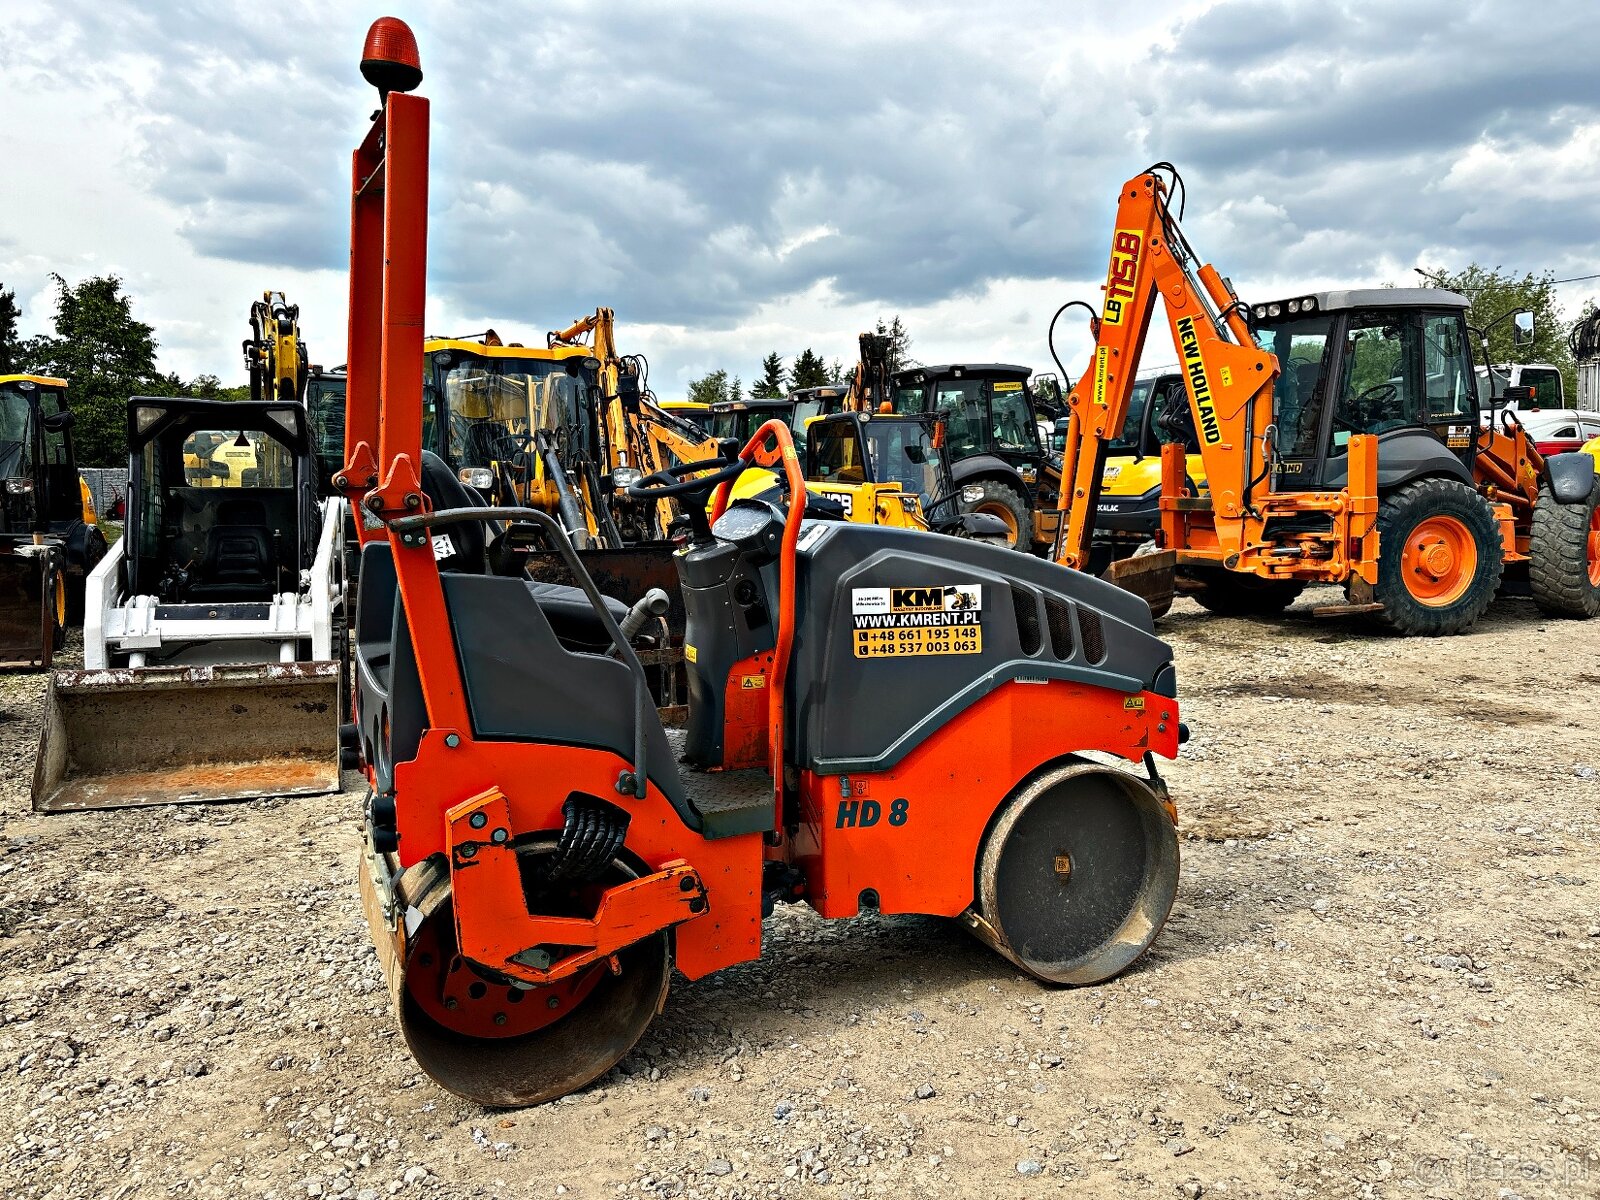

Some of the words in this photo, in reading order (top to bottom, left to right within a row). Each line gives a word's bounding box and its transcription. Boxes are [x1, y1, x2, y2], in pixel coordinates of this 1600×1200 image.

[1105, 300, 1121, 323] LB
[1177, 317, 1200, 359] NEW
[1097, 347, 1107, 402] www.kmrent.pl
[1188, 362, 1220, 444] HOLLAND
[893, 589, 943, 607] KM
[854, 612, 980, 628] WWW.KMRENT.PL
[870, 631, 895, 641] +48
[898, 630, 921, 640] 661
[926, 629, 949, 639] 195
[954, 628, 977, 638] 148
[871, 644, 895, 654] +48
[899, 643, 922, 653] 537
[926, 642, 949, 652] 003
[953, 641, 977, 651] 063
[836, 800, 881, 828] HD
[888, 798, 909, 827] 8
